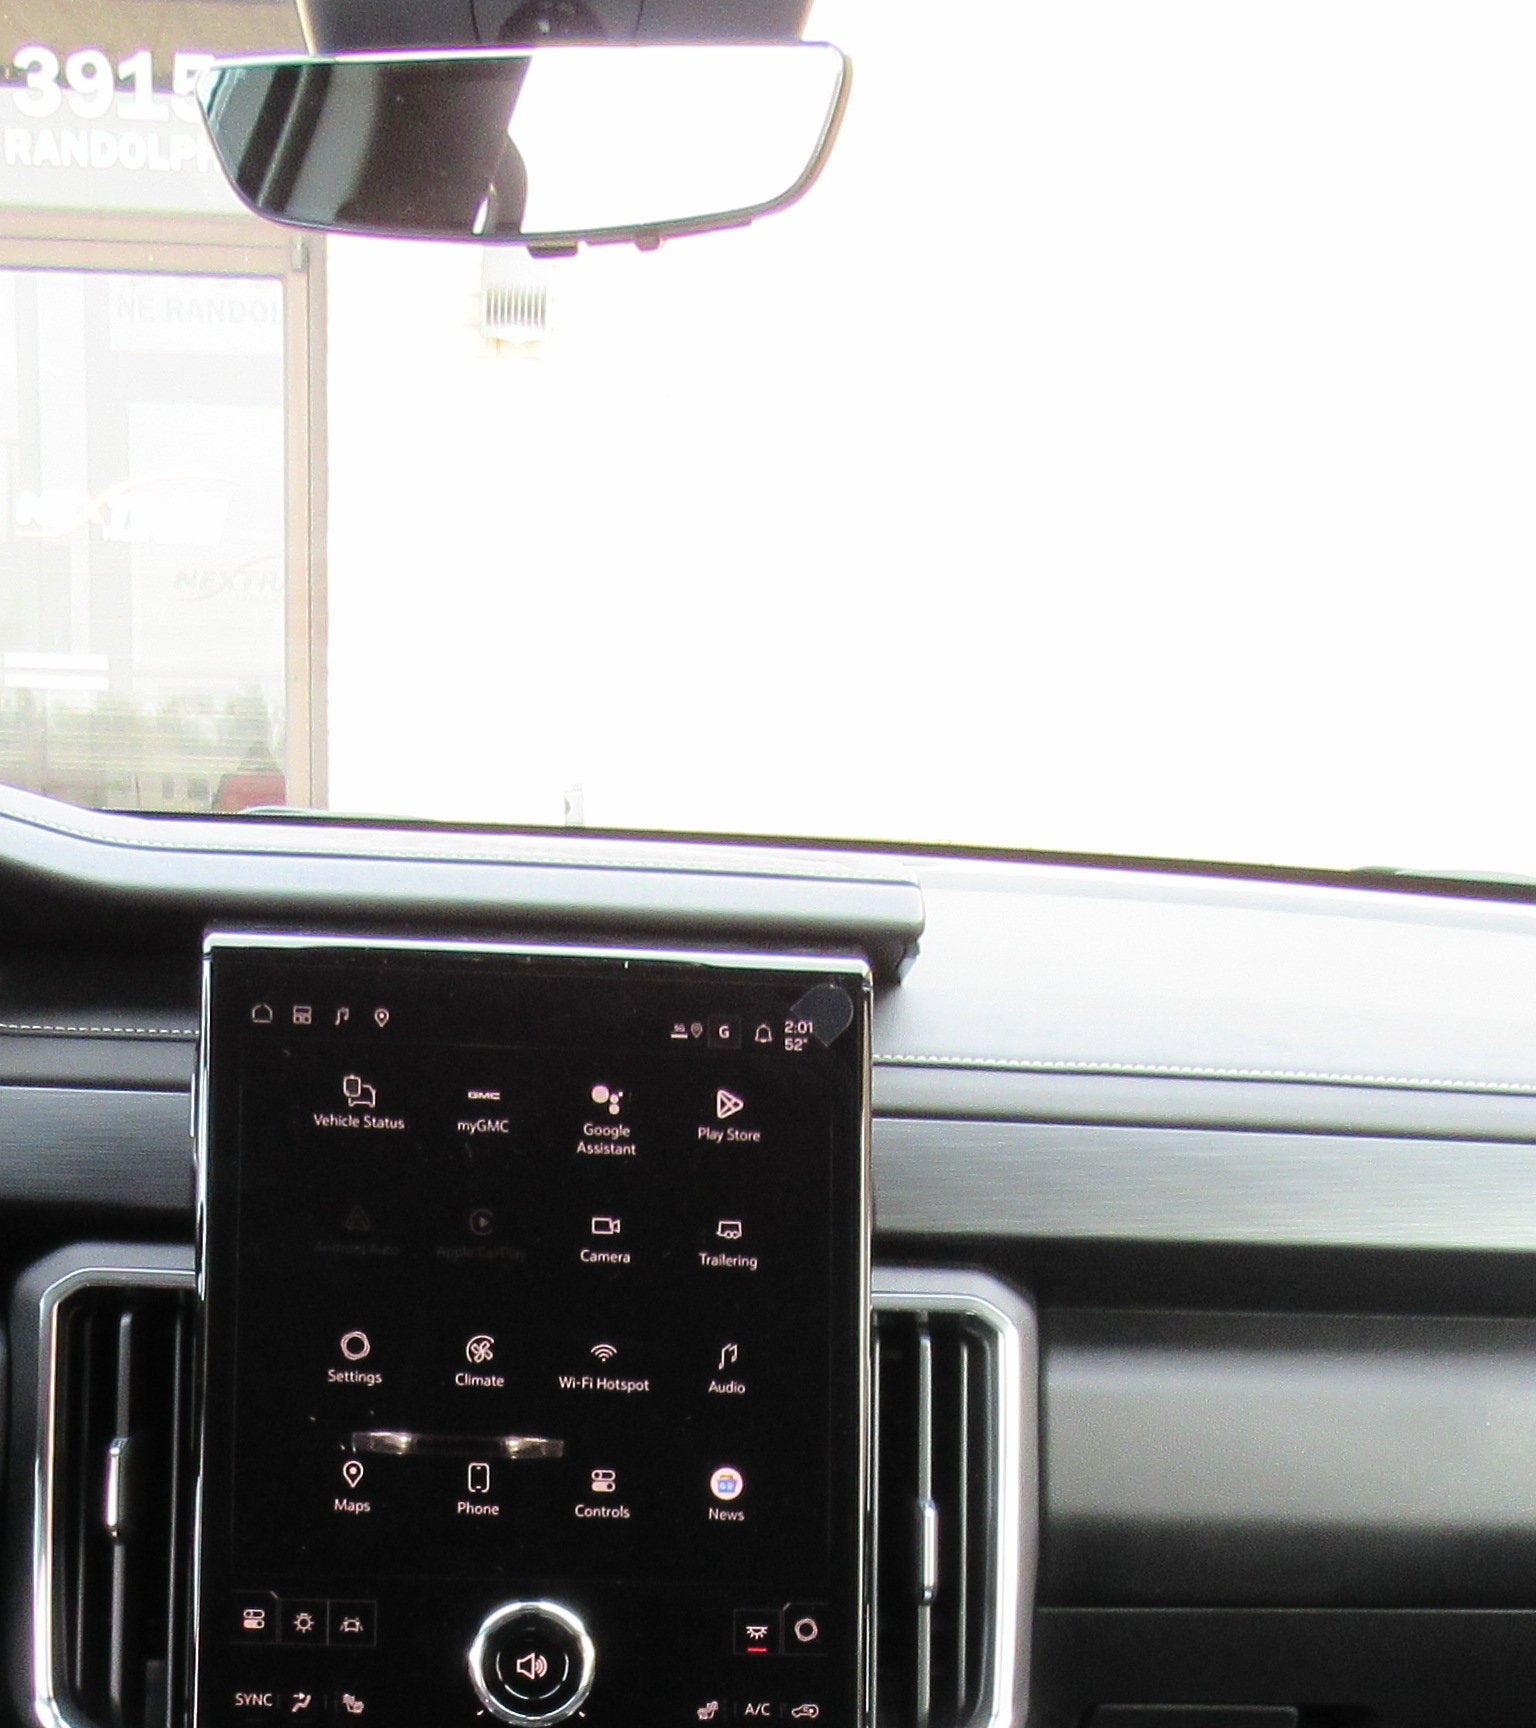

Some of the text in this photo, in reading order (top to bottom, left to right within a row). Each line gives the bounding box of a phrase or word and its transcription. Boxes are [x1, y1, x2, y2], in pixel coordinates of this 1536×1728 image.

[718, 1025, 730, 1039] G
[784, 1020, 813, 1034] 2:01
[313, 1113, 405, 1130] Vehicle Status
[457, 1119, 509, 1135] myGMC
[583, 1122, 631, 1140] Google
[697, 1126, 761, 1143] Play Store
[576, 1141, 636, 1156] Assistant
[580, 1249, 631, 1264] Camera
[699, 1252, 758, 1271] Trailering
[327, 1369, 383, 1387] Settings
[455, 1372, 505, 1387] Climate
[558, 1376, 650, 1393] Wi-Fi Hotspot
[708, 1380, 746, 1394] Audio
[334, 1498, 371, 1515] Maps
[457, 1501, 500, 1516] Phone
[574, 1504, 631, 1519] Controls
[708, 1507, 745, 1521] News
[235, 1692, 273, 1707] SYNC
[744, 1703, 770, 1716] A/C
